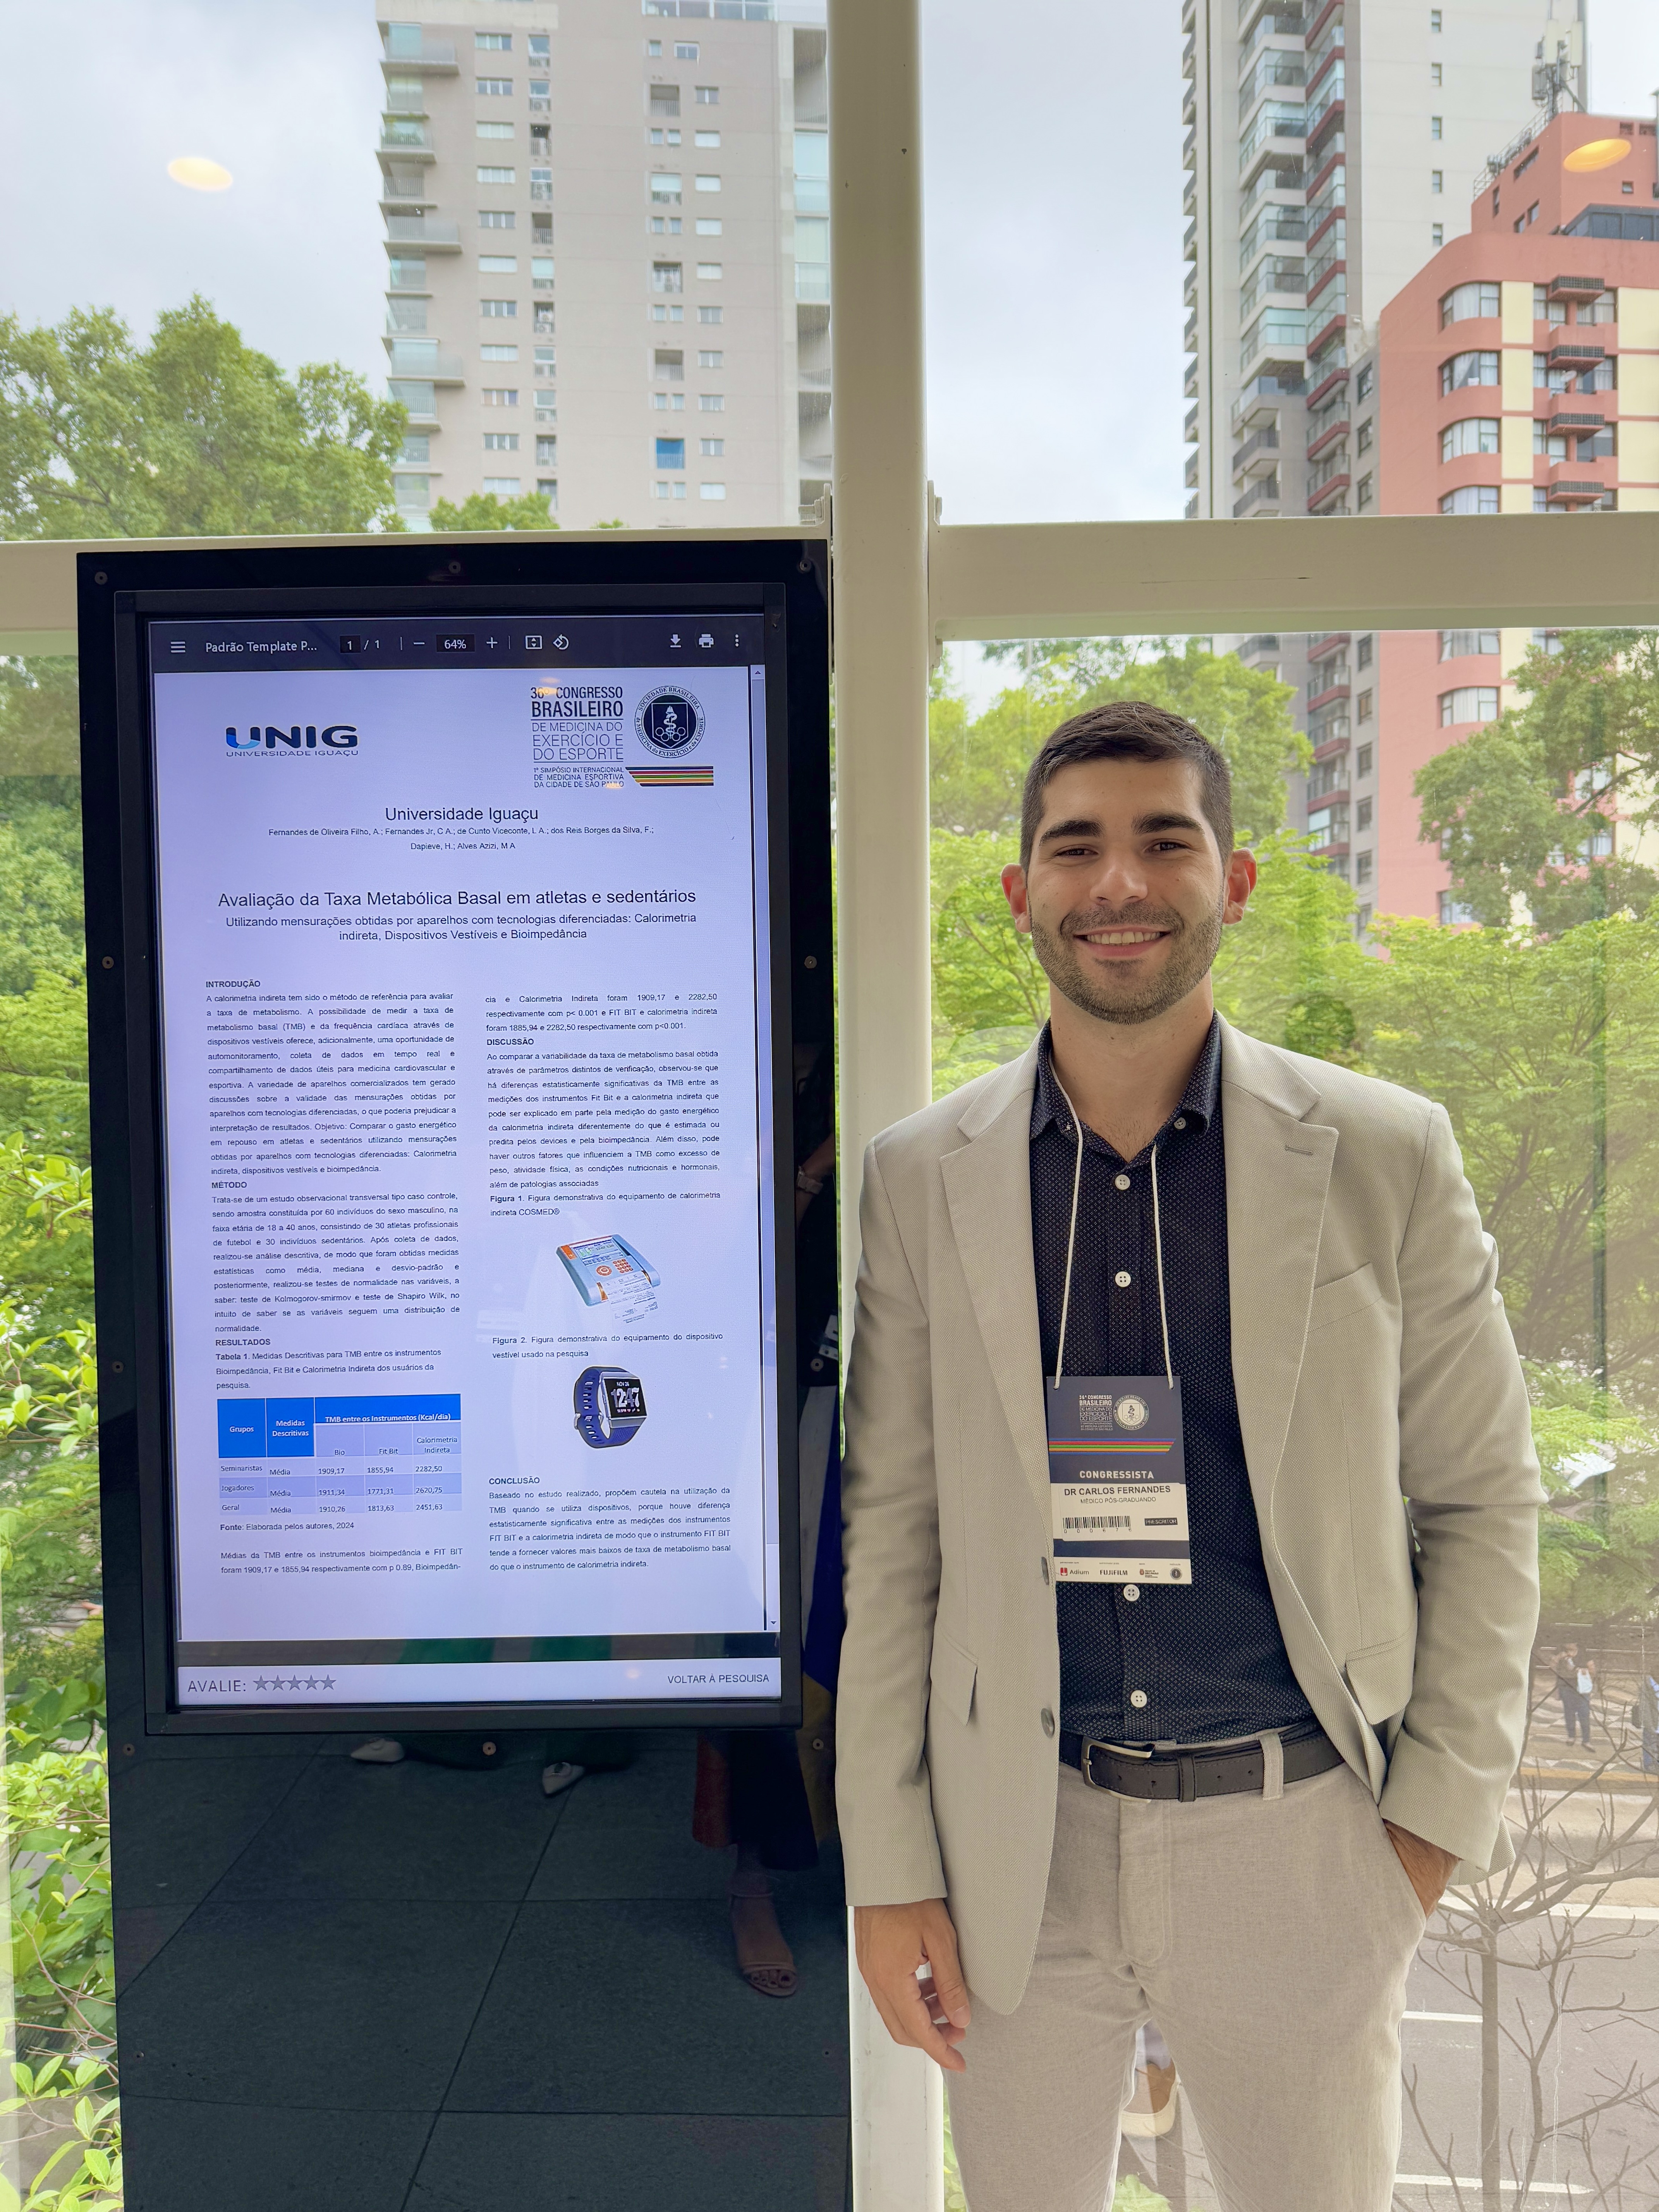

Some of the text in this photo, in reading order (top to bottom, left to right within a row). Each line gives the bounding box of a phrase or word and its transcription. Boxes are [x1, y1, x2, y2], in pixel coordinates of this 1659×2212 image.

[206, 642, 243, 652] Padrão
[247, 641, 297, 653] Template
[348, 641, 351, 650] 1
[375, 640, 379, 648] 1
[445, 639, 466, 649] 64%
[556, 687, 622, 699] CONGRESSO
[639, 687, 700, 711] SOCIEDADE BRASILEIRA
[532, 701, 623, 717] BRASILEIRO
[532, 722, 622, 733] DE MEDICINA DO
[226, 726, 357, 749] UNIG
[533, 732, 623, 746] EXERCÍCIO E
[534, 748, 623, 760] DO ESPORTE
[386, 807, 538, 823] Universidade Iguaçu
[218, 890, 696, 910] Avaliação da Taxa Metabólica Basal em atletas e sedentários
[227, 917, 277, 926] Utilizando
[281, 917, 352, 927] mensurações
[356, 916, 393, 925] obtidas
[397, 918, 414, 927] por
[417, 916, 468, 926] aparelhos
[497, 915, 556, 926] tecnologias
[560, 914, 630, 923] diferenciadas:
[635, 914, 696, 922] Calorimetria
[340, 931, 381, 941] indireta,
[385, 931, 447, 941] Dispositivos
[450, 930, 498, 939] Vestíveis
[512, 929, 586, 940] Bioimpedância
[206, 979, 260, 988] INTRODUÇÃO
[668, 1675, 706, 1683] VOLTAR
[709, 1674, 715, 1683] À
[188, 1680, 246, 1692] AVALIE:
